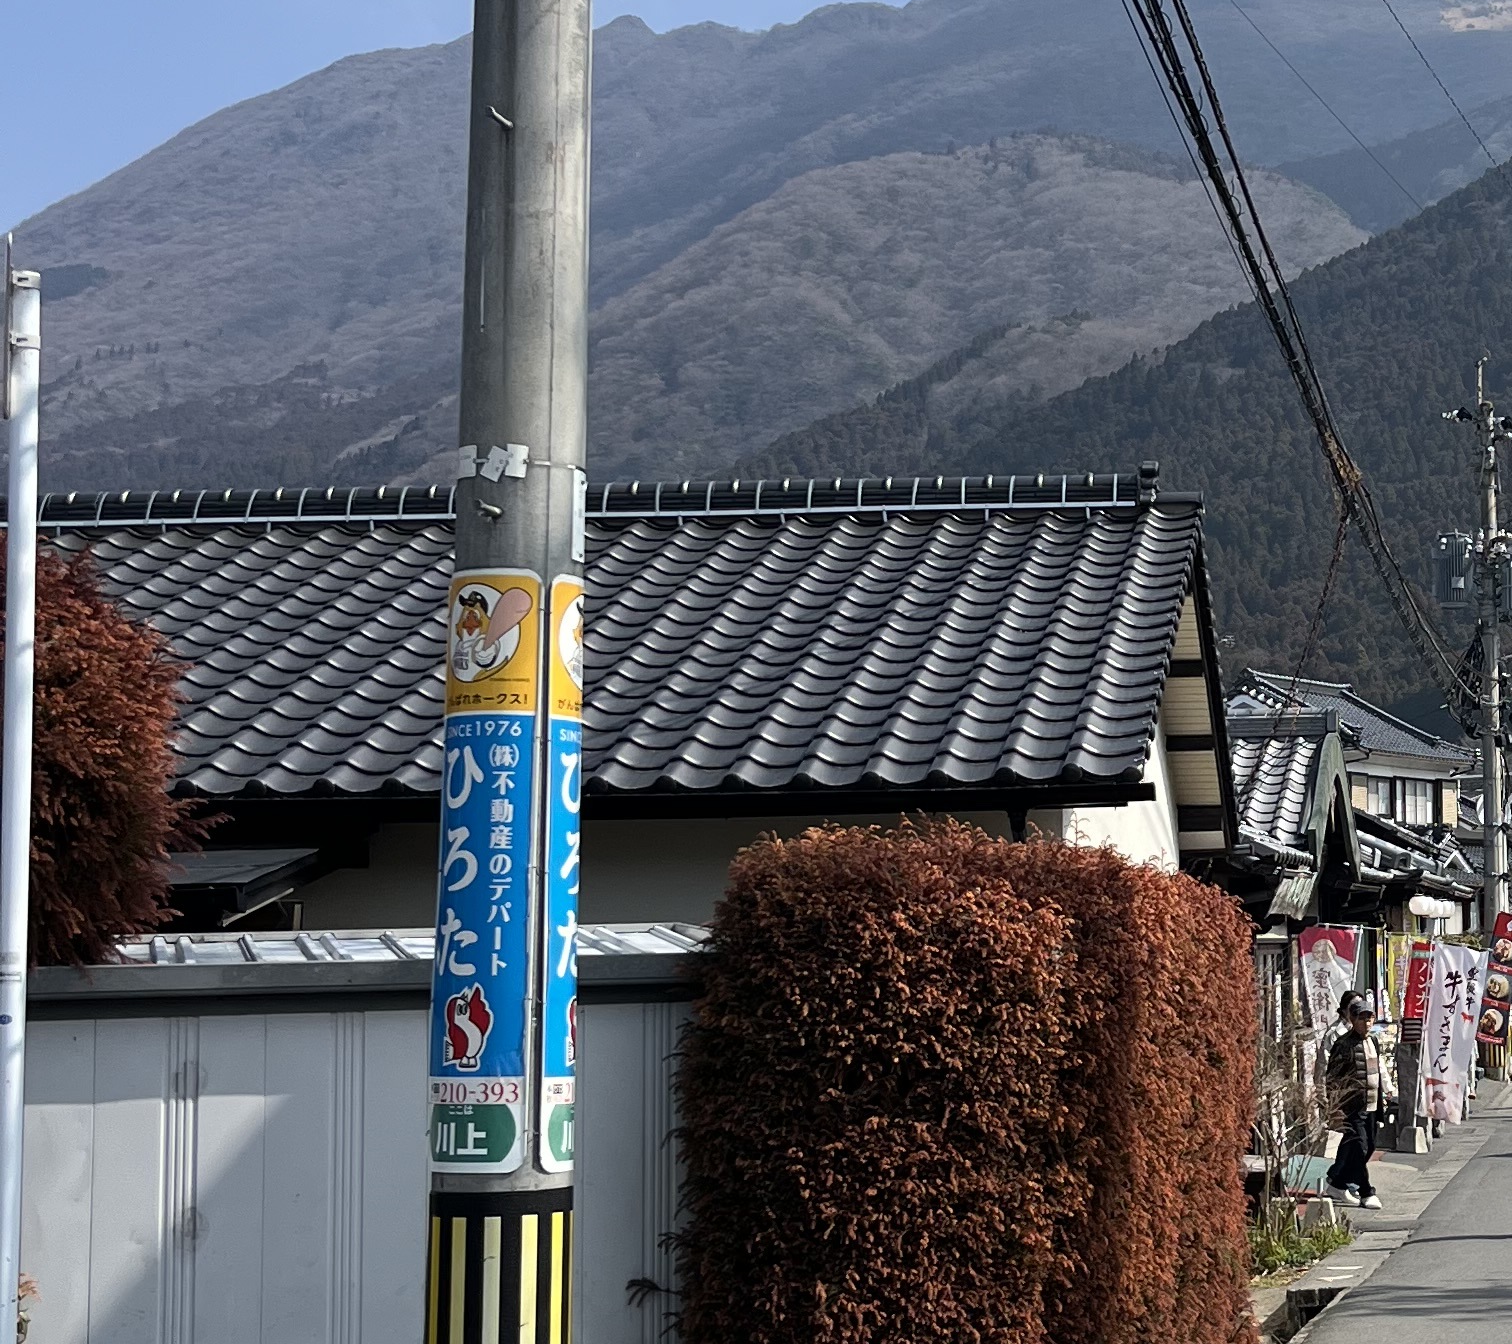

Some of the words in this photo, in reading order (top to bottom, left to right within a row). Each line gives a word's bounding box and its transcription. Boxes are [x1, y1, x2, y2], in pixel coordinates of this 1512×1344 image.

[475, 720, 523, 737] 1976
[439, 744, 485, 977] ひろた
[435, 1121, 488, 1156] 川上
